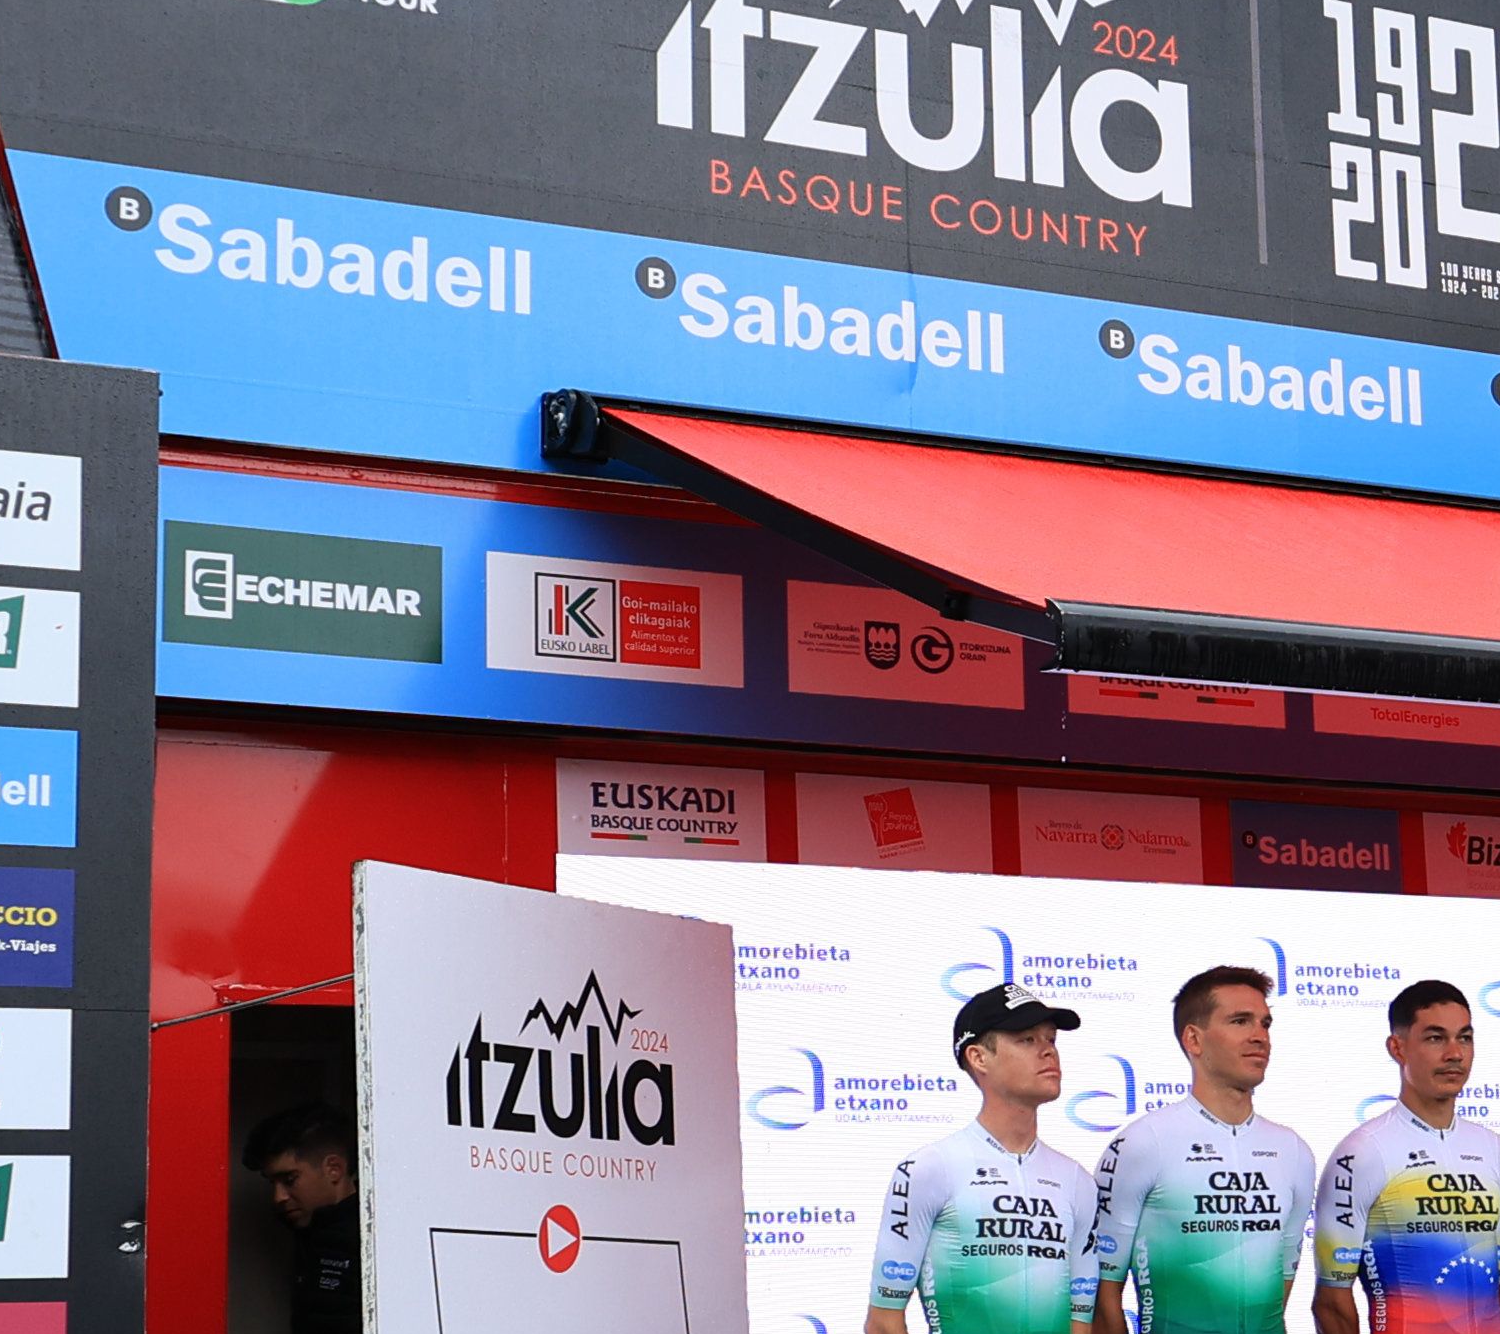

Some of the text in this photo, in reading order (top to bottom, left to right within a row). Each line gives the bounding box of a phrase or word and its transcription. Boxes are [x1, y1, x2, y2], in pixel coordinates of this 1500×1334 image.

[1092, 21, 1178, 66] 2024
[710, 159, 1148, 257] BASQUE COUNTRY
[155, 202, 531, 315] Sabadell
[1440, 261, 1459, 277] 100
[1462, 264, 1493, 284] YEARS
[1441, 278, 1467, 296] 1924
[678, 272, 1004, 374] Sabadell
[1137, 334, 1422, 427] Sabadell
[235, 574, 421, 617] ECHEMAR
[1370, 707, 1460, 729] TotalEnergies
[590, 781, 736, 815] EUSKADI
[590, 813, 739, 834] BASQUE COUNTRY
[1258, 835, 1390, 872] Sabadell
[630, 1028, 669, 1053] 2024
[834, 1074, 957, 1092] amorebieta
[834, 1095, 908, 1111] etxano
[469, 1145, 657, 1182] BASQUE COUNTRY
[1208, 1171, 1270, 1192] CAJA
[891, 1159, 915, 1241] ALEA
[993, 1194, 1058, 1218] CAJA
[1194, 1193, 1281, 1215] RURAL
[975, 1218, 1066, 1243] RURAL
[1181, 1218, 1281, 1234] SEGUROS RGA
[961, 1243, 1067, 1261] SEGUROS RGA
[882, 1263, 915, 1279] KMC
